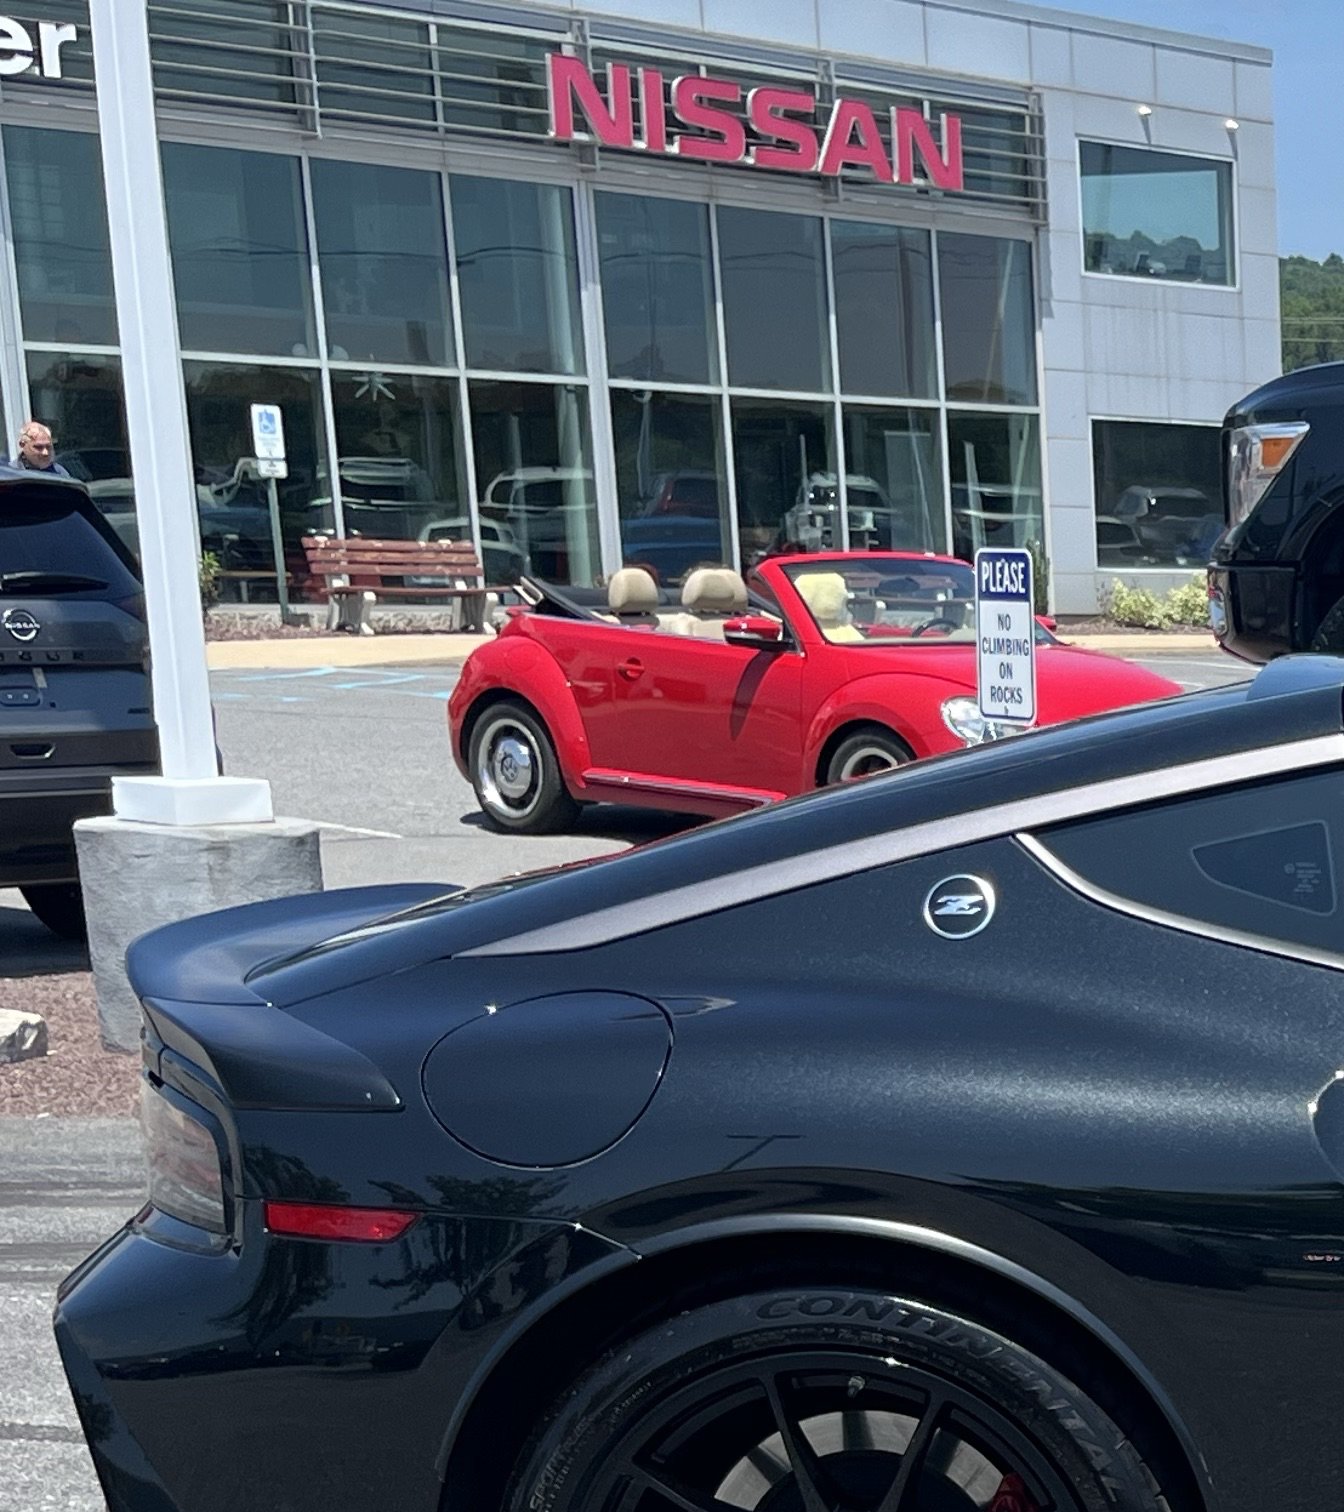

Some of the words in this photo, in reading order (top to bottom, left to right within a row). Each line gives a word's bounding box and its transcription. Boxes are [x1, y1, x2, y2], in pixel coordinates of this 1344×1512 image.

[545, 52, 964, 192] NISSAN
[981, 560, 1026, 593] PLEASE
[997, 613, 1012, 632] NO
[981, 635, 1030, 657] CLIMBING
[999, 662, 1013, 680] ON
[990, 685, 1023, 705] ROCKS
[757, 1298, 1121, 1502] CONTINENTAL
